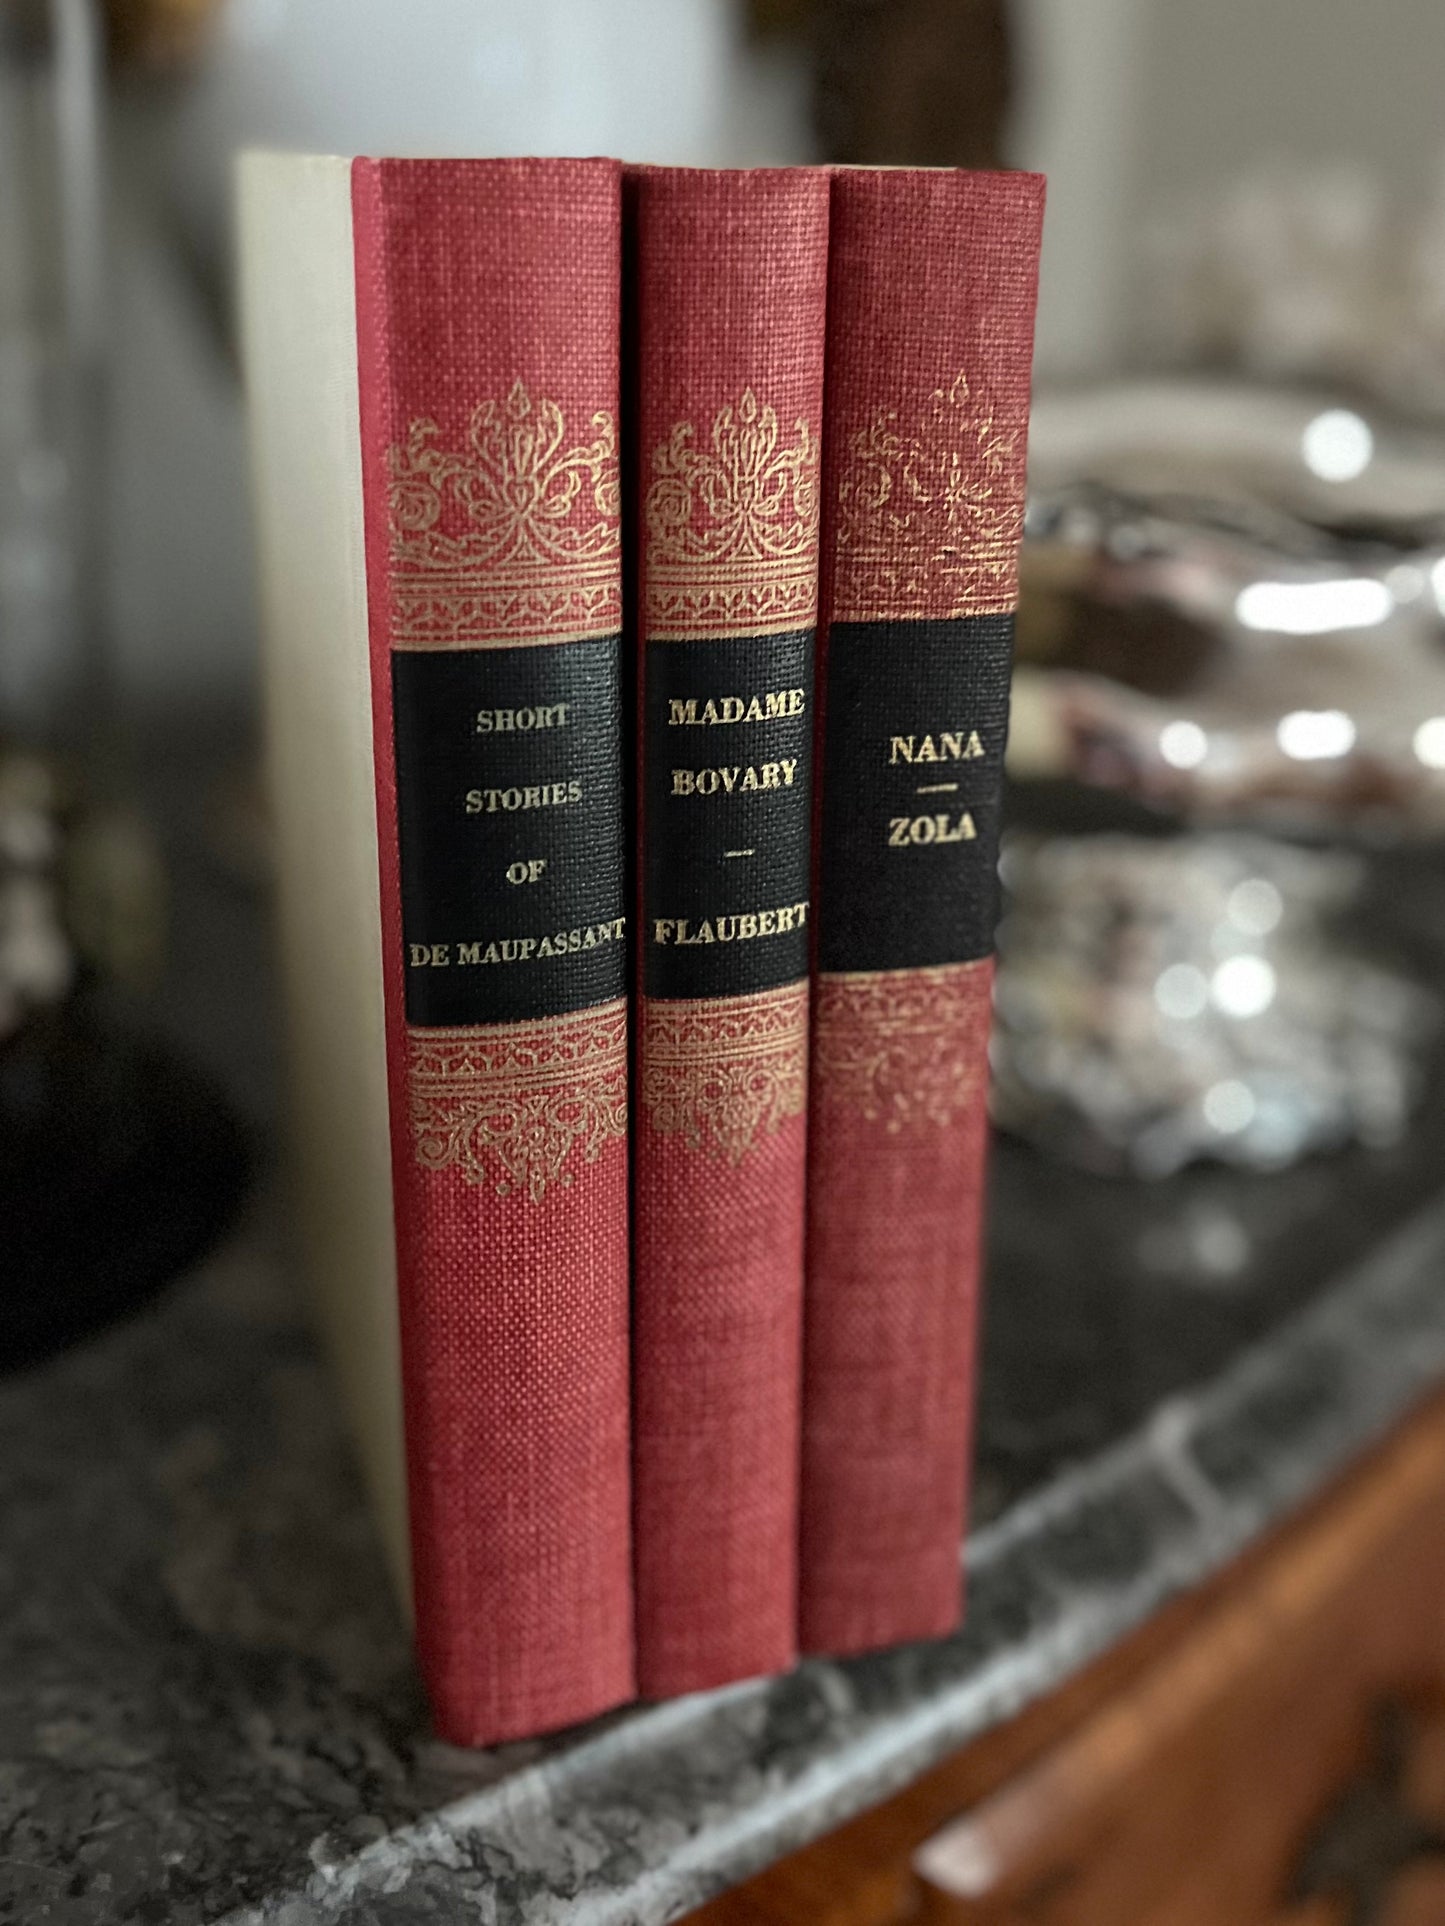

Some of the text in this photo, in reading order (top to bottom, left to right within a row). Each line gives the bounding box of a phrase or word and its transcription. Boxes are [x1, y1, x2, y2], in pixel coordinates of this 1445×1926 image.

[476, 703, 570, 733] SHORT
[668, 688, 805, 725] MADAME
[888, 730, 985, 765] NANA
[671, 759, 797, 795] BOVARY
[465, 780, 583, 814] STORIES
[888, 811, 977, 846] ZOLA
[506, 860, 546, 884] OF
[653, 901, 810, 945] FLAUBERT
[409, 917, 626, 967] DE MAUPASSANT
